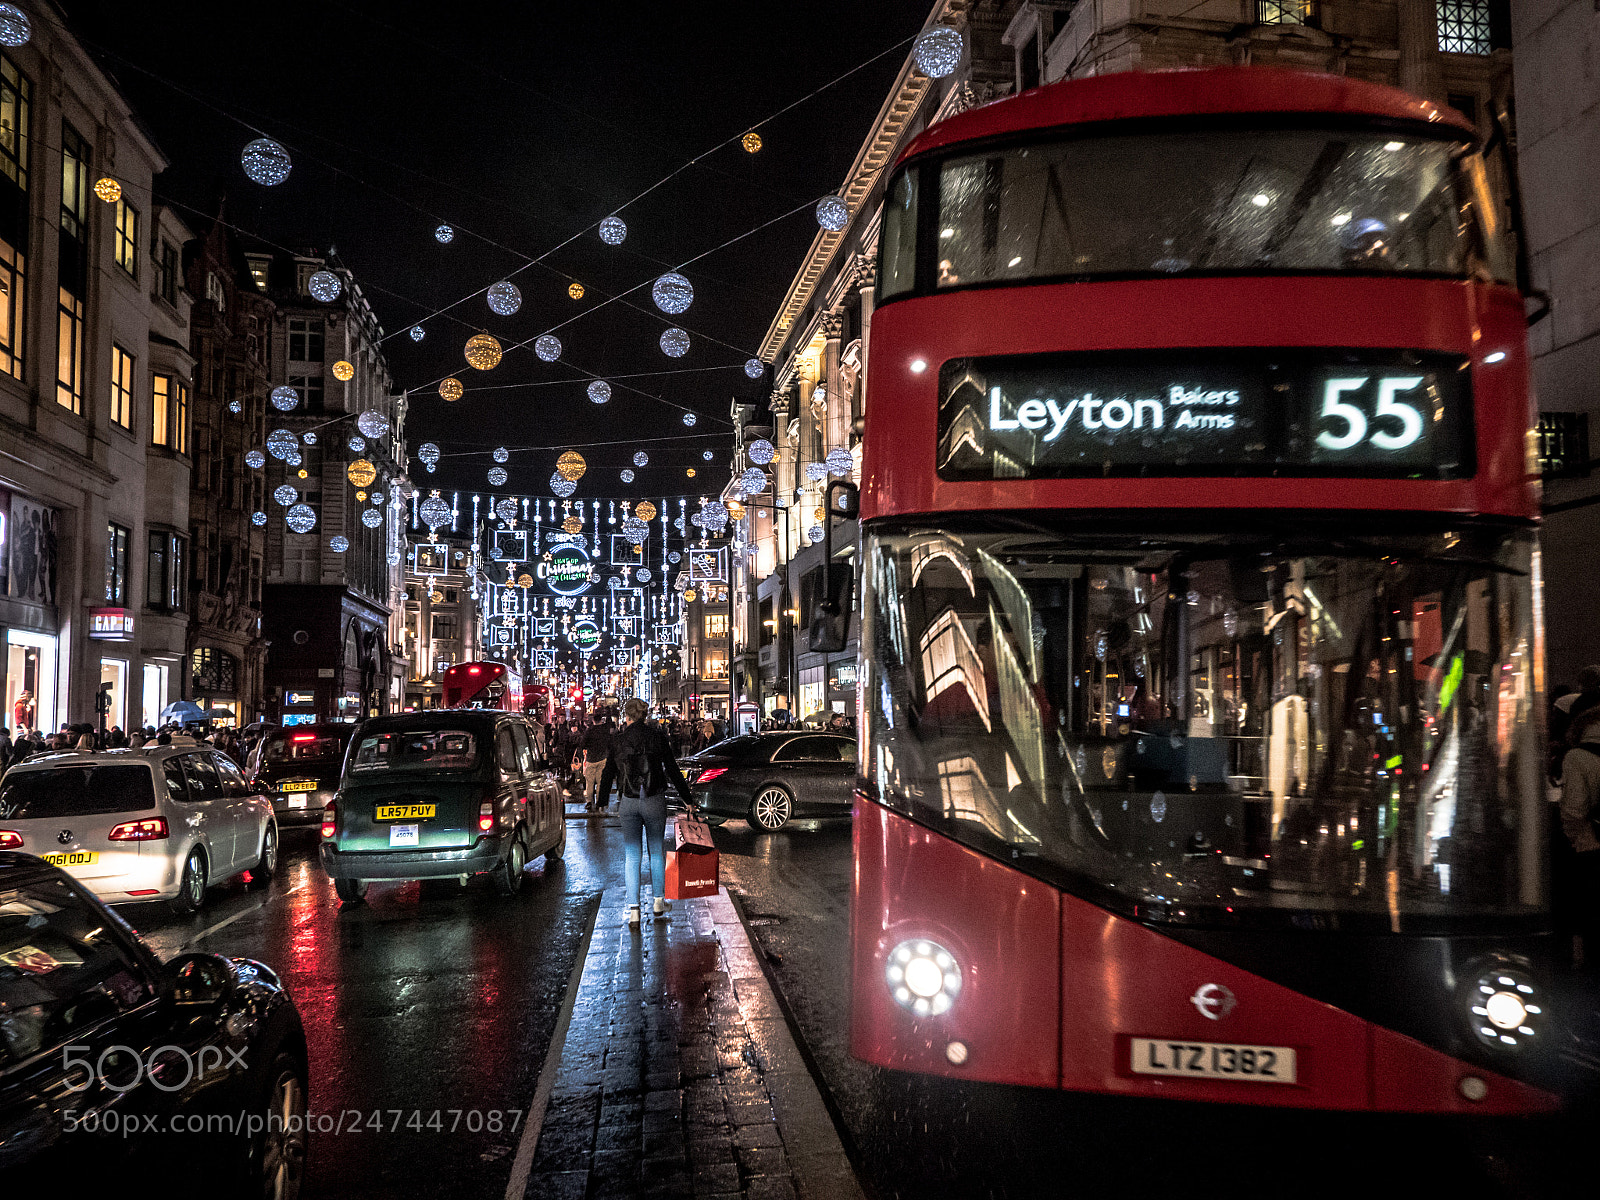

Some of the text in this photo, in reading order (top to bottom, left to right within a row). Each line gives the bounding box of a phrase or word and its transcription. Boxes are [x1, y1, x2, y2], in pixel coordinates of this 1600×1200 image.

[1169, 385, 1240, 406] Bakers
[989, 386, 1164, 442] Leyton
[1174, 409, 1236, 430] Arms
[1315, 376, 1425, 450] 55
[536, 560, 596, 580] Christmas
[554, 595, 577, 610] sky
[95, 615, 117, 632] GAP
[471, 700, 483, 709] 73
[381, 805, 431, 818] LR57 PUY
[69, 852, 92, 864] ODJ
[1148, 1042, 1277, 1076] LTZ 1382
